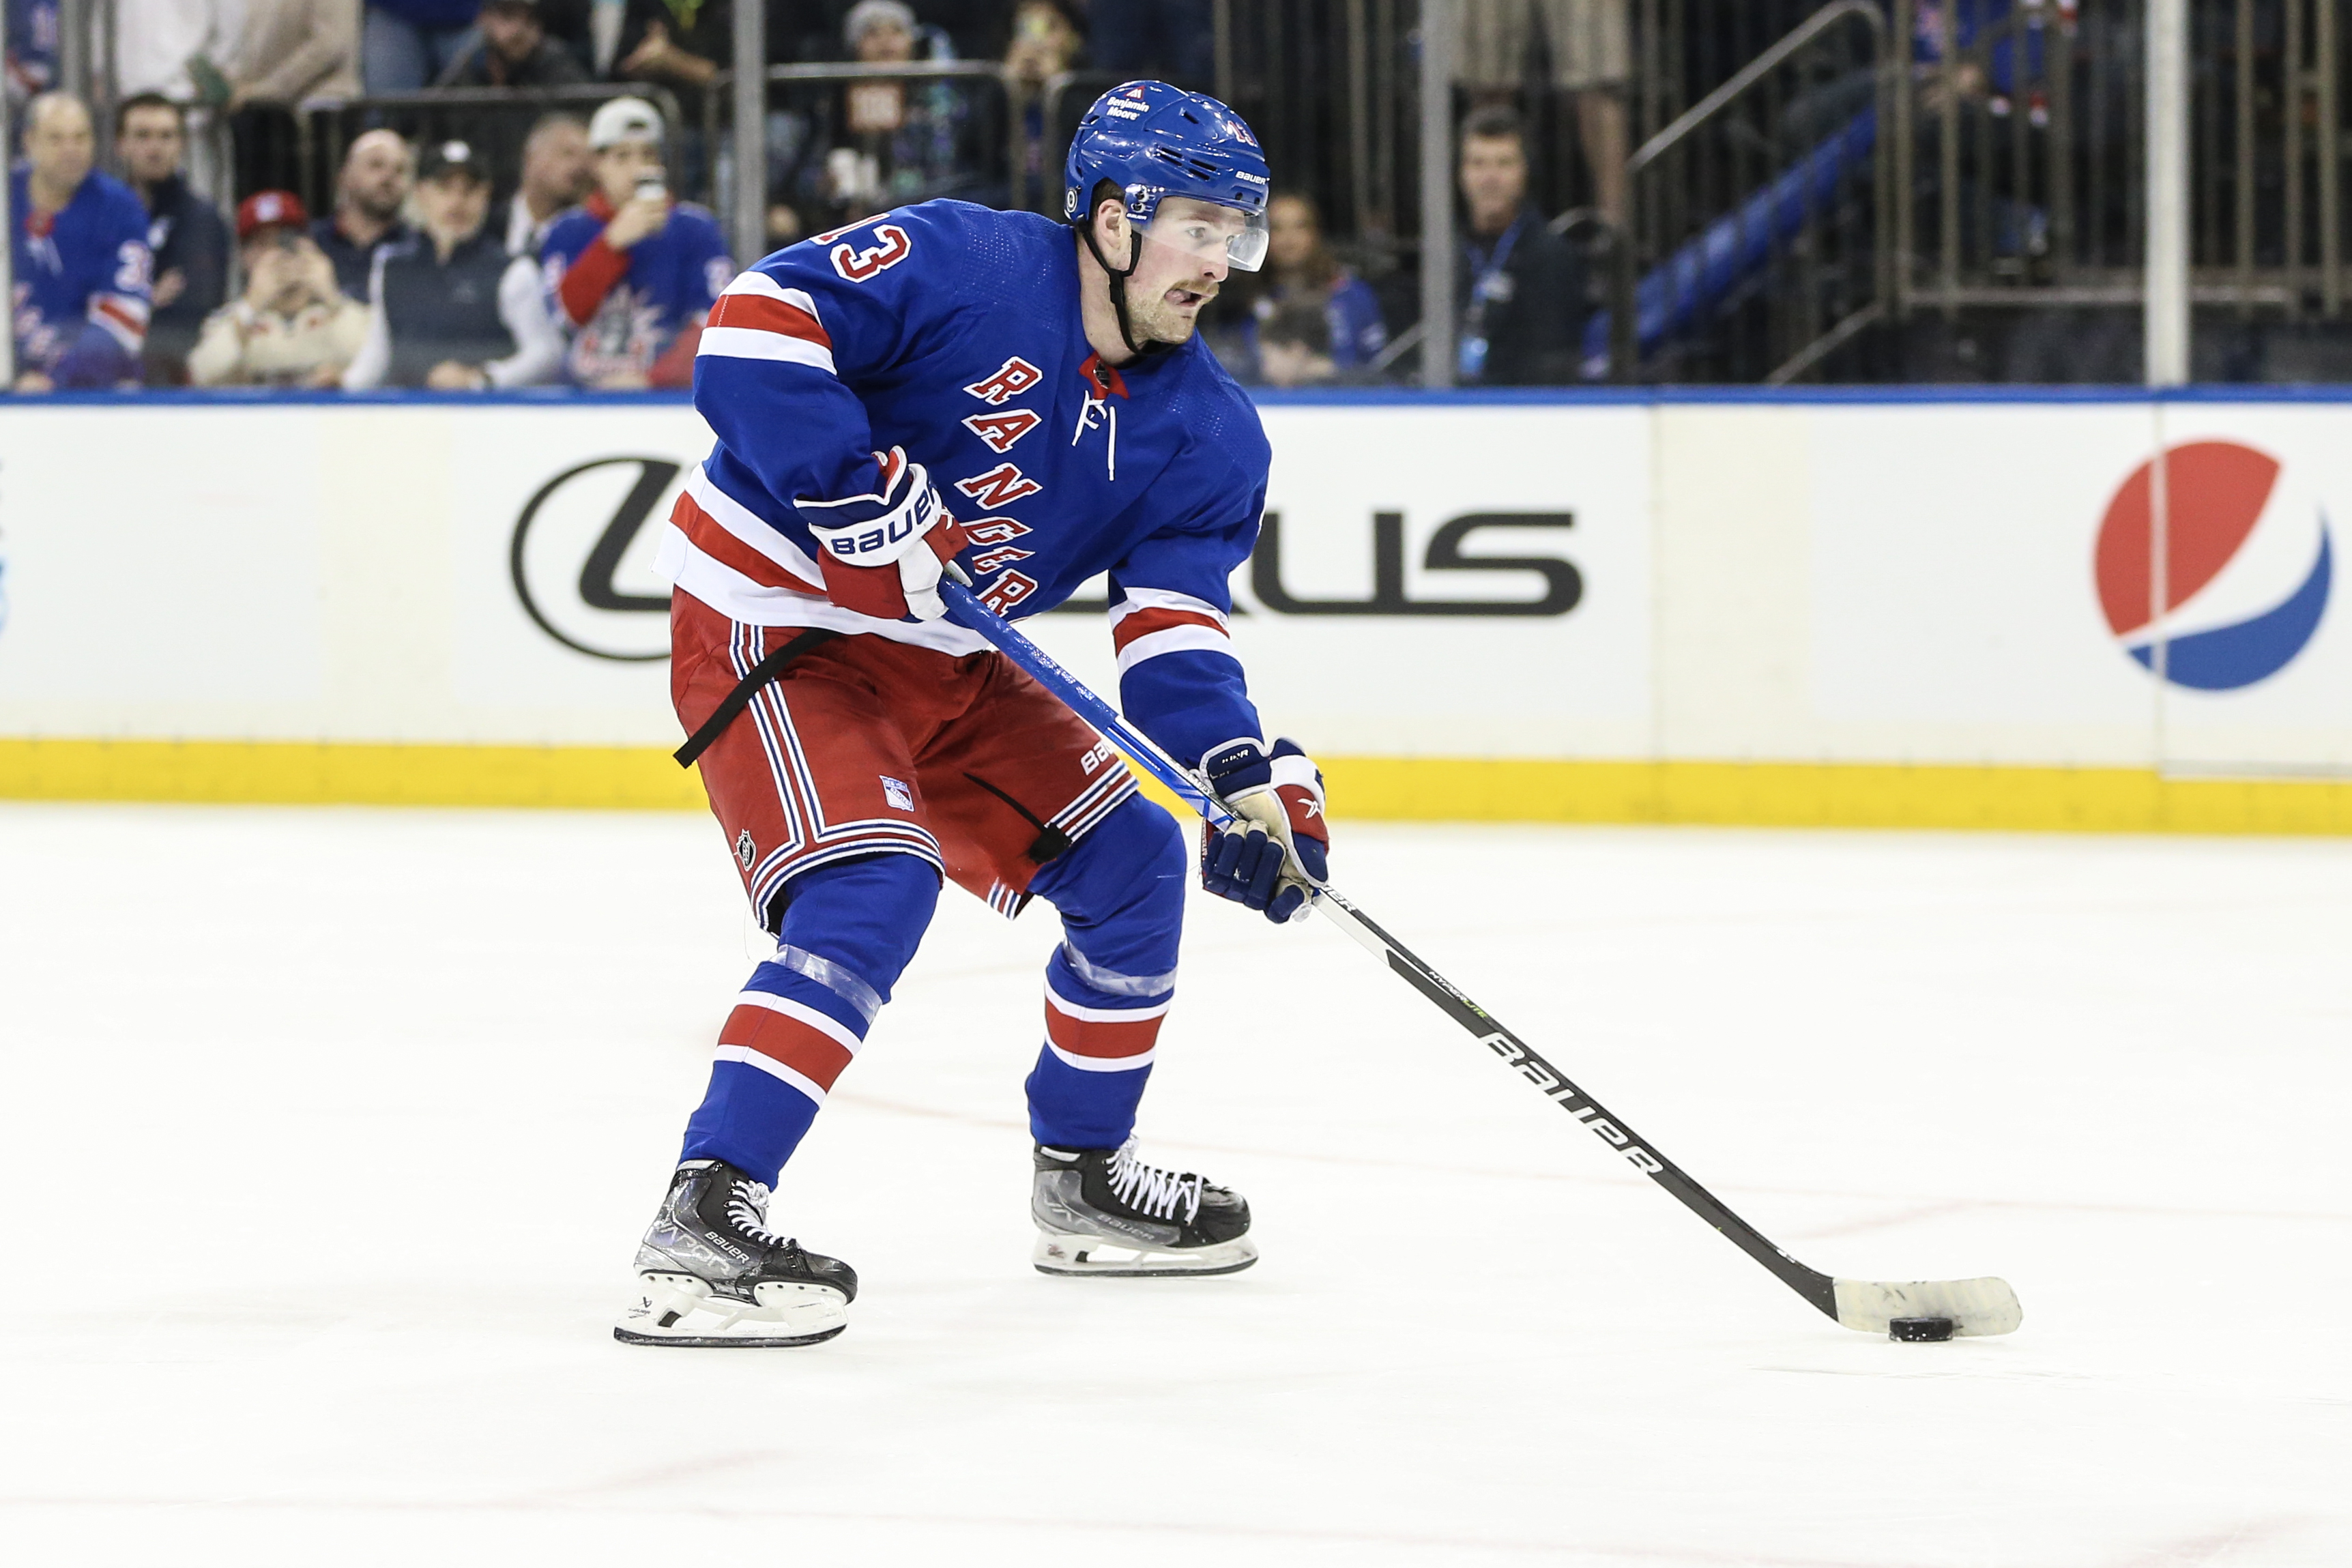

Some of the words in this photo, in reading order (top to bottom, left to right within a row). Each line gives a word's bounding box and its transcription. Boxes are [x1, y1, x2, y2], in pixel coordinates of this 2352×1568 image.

[1107, 96, 1150, 113] Benjamin
[1107, 106, 1137, 121] Moore
[1479, 1032, 1664, 1174] BAUER
[704, 1230, 750, 1264] BAUER
